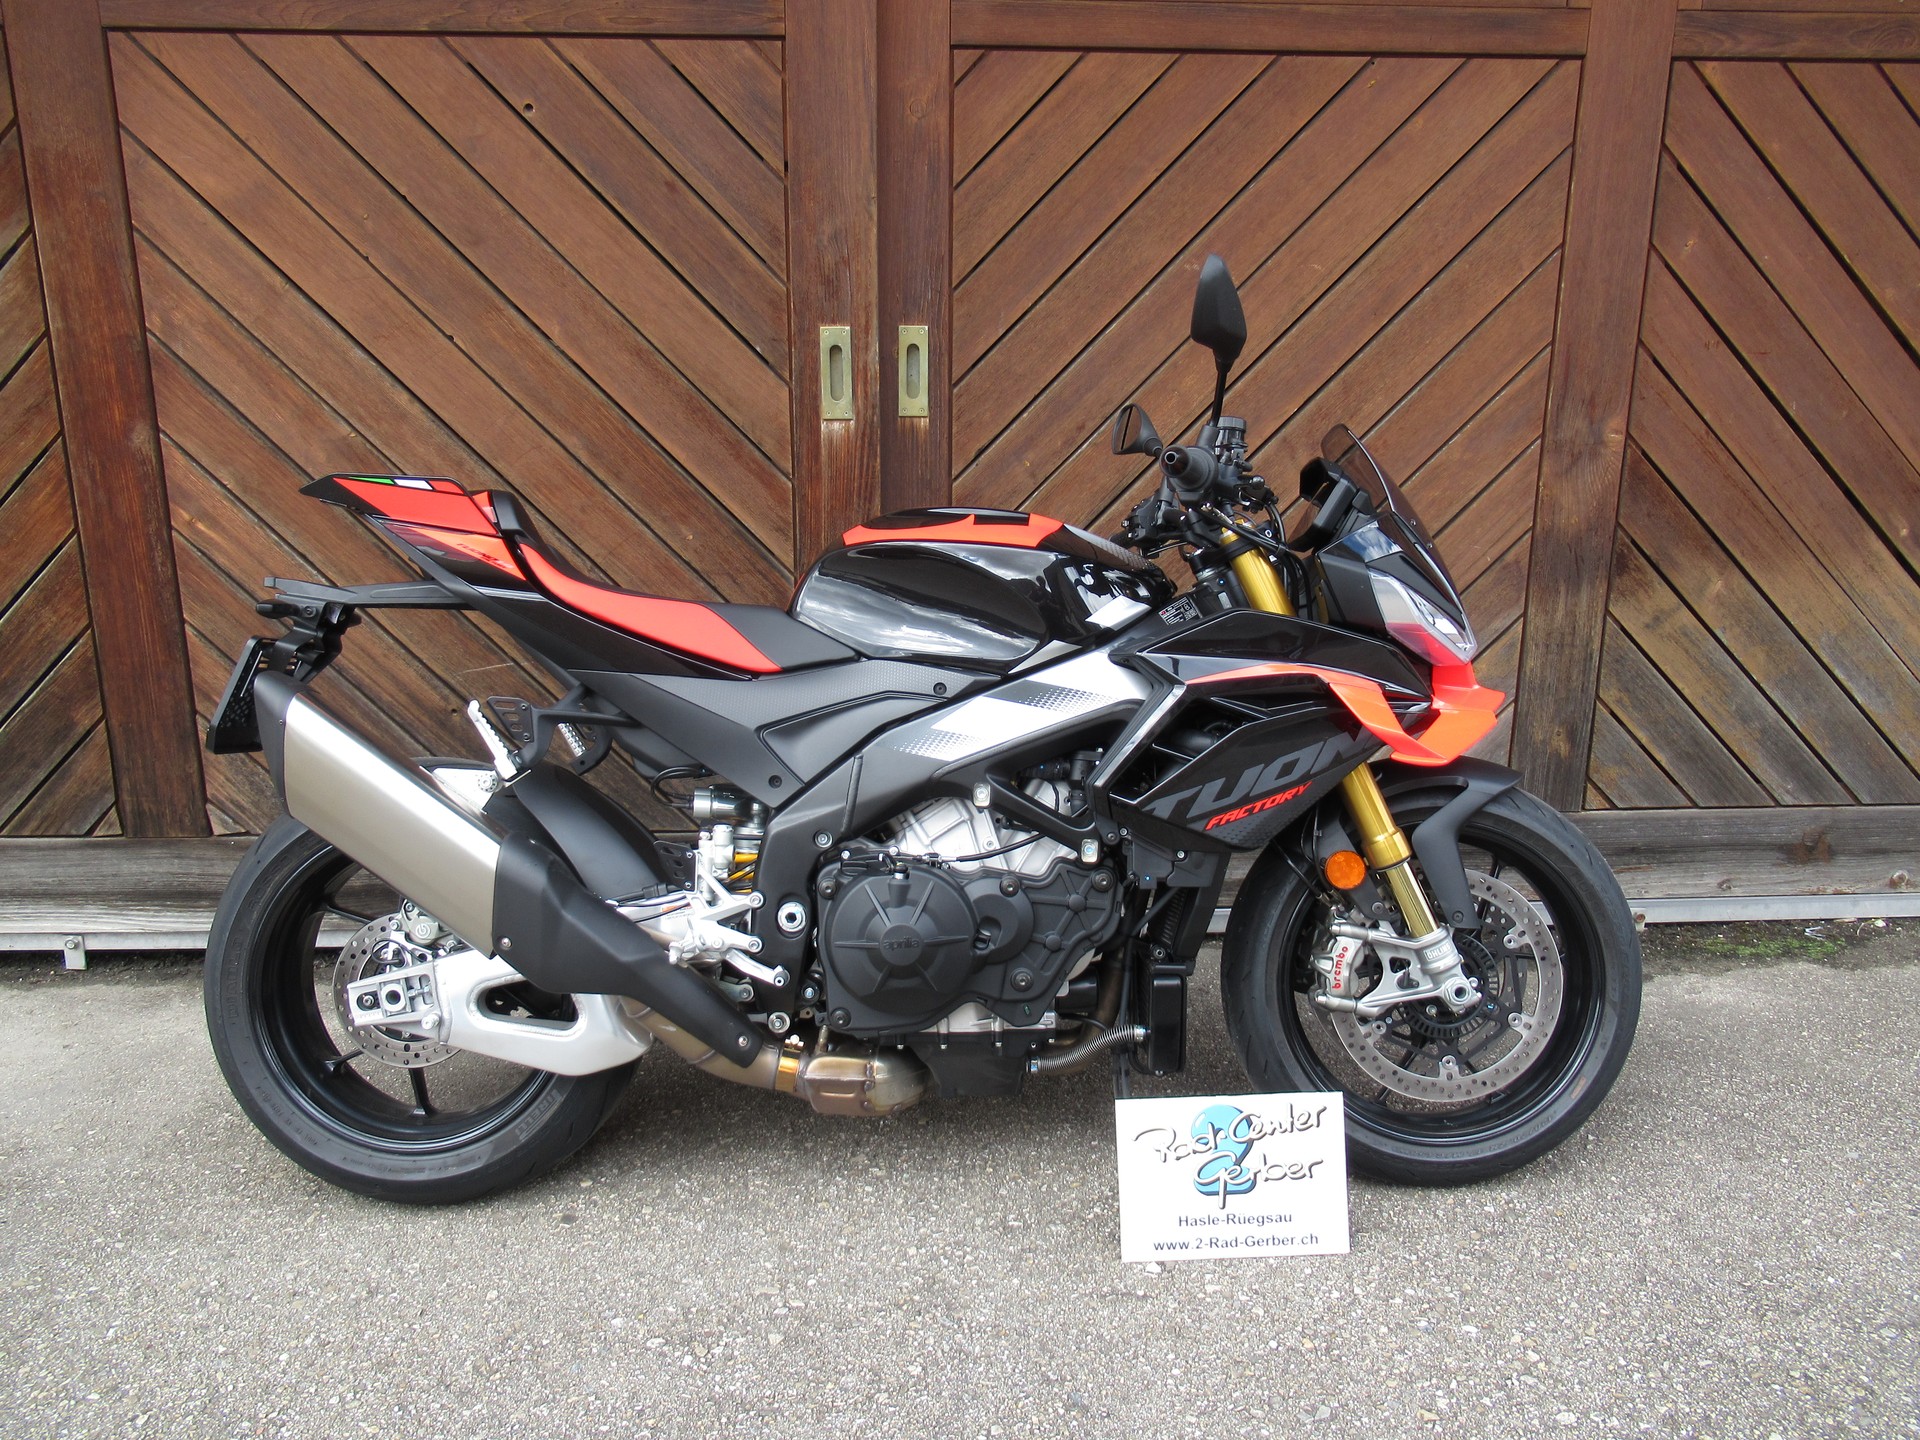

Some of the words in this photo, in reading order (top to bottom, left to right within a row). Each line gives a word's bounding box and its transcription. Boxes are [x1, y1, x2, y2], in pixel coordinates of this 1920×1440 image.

[1205, 781, 1313, 830] FACTORY
[883, 936, 921, 950] aprilia
[1332, 946, 1348, 990] brembo
[1194, 1151, 1323, 1209] Gerber
[1178, 1213, 1293, 1228] Hasle-Rüegsau
[1153, 1233, 1319, 1251] www.2-Rad-Gerber.ch
